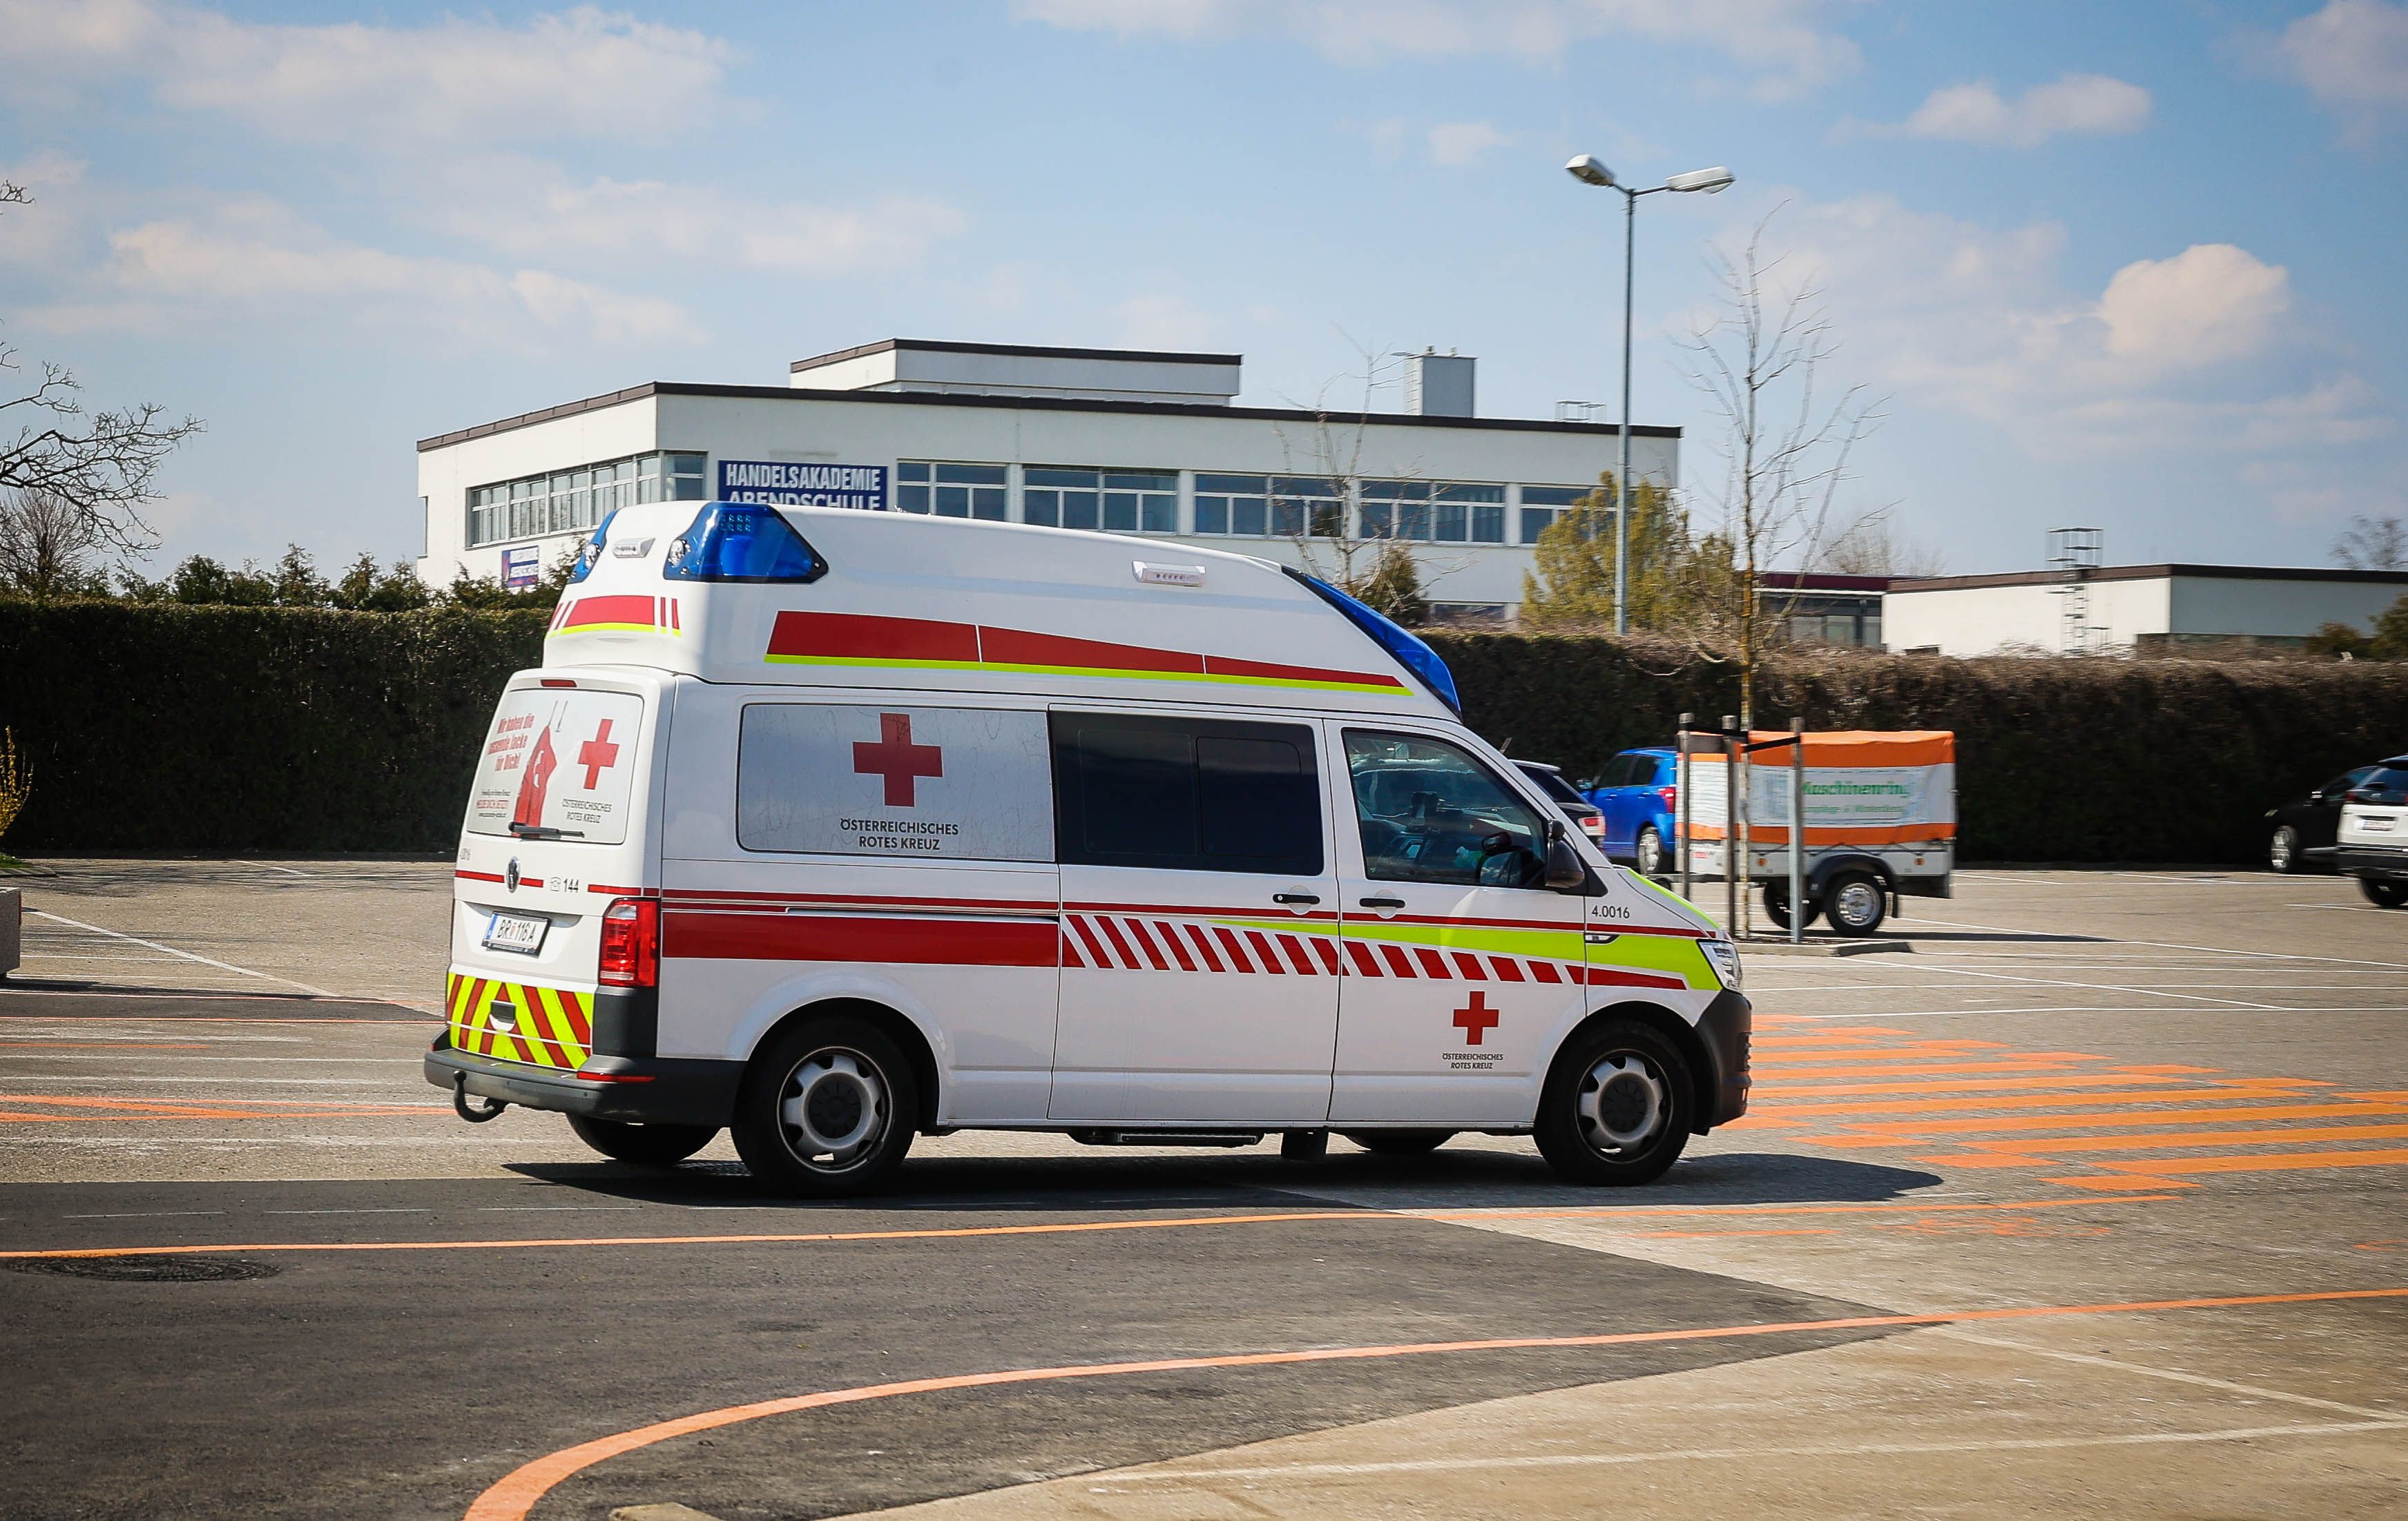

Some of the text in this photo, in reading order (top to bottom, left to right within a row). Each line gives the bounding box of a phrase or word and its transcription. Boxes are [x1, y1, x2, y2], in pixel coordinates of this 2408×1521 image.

[726, 463, 881, 491] HANDELSAKADEMIE
[566, 811, 601, 824] ROTES KREUZ
[840, 817, 959, 835] ÖSTERREICHISCHES
[859, 835, 941, 851] ROTES KREUZ
[564, 878, 579, 893] 144
[1590, 905, 1630, 919] 4.0016
[1442, 1052, 1503, 1060] ÖSTERREICHISCHES
